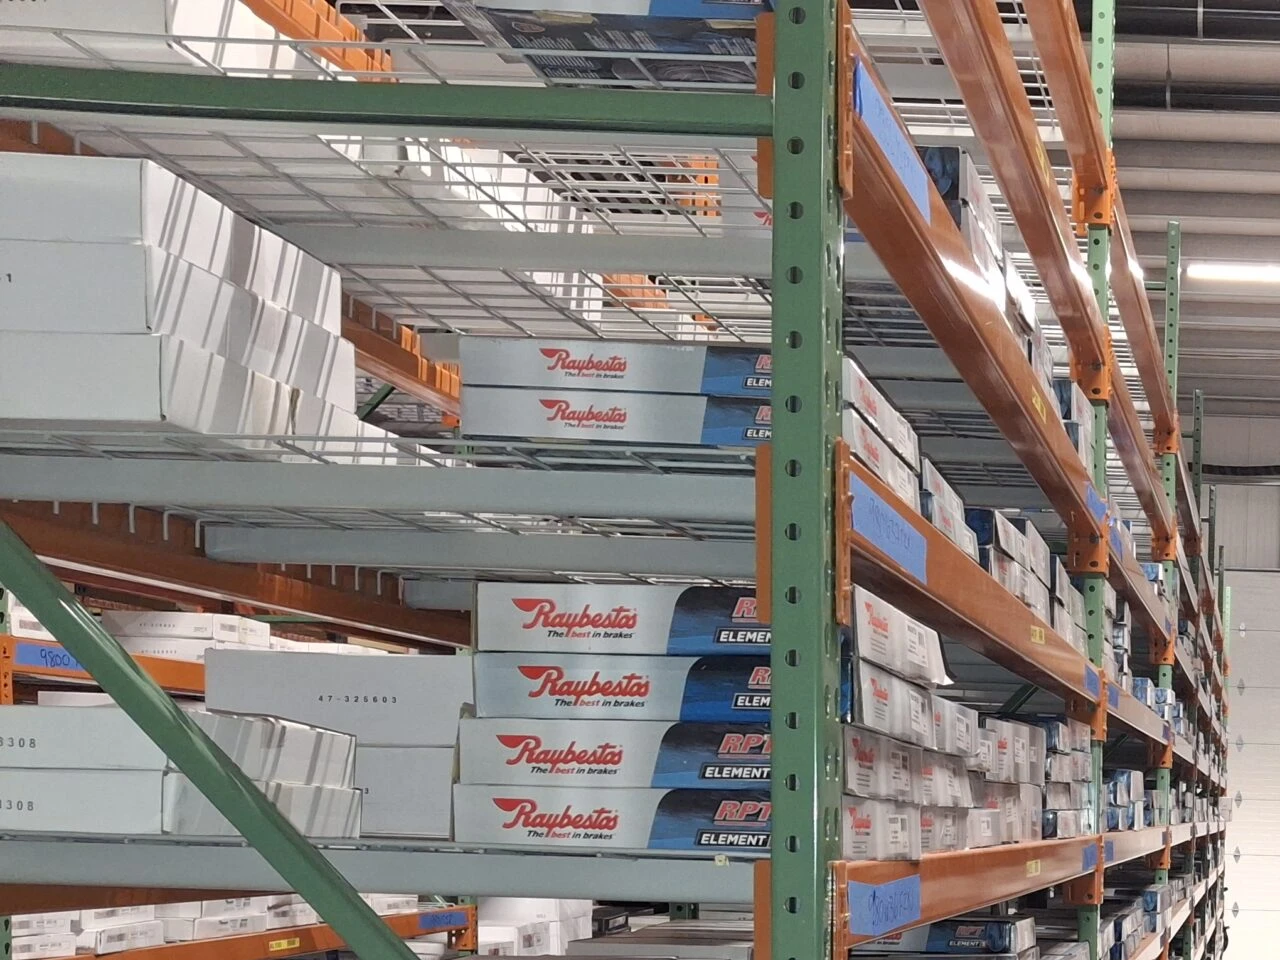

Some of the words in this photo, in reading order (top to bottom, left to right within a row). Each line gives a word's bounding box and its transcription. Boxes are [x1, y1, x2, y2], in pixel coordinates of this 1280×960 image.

[538, 348, 627, 377] Raybestos
[746, 378, 772, 388] ELEM
[538, 399, 627, 428] Raybestos
[746, 429, 772, 439] ELEM
[511, 598, 638, 638] Raybestos
[547, 630, 564, 638] The
[570, 630, 591, 639] best
[592, 630, 602, 639] in
[603, 630, 634, 640] brakes
[517, 665, 650, 706] Raybestos
[554, 699, 572, 707] The
[578, 698, 600, 707] best
[601, 699, 611, 707] in
[612, 699, 646, 708] brakes
[736, 696, 770, 707] ELEM
[495, 734, 624, 774] Raybestos
[530, 766, 548, 774] The
[555, 766, 576, 775] best
[576, 766, 586, 775] in
[587, 767, 619, 776] brakes
[704, 767, 770, 779] ELEMENT
[493, 797, 619, 837] Raybestos
[527, 830, 545, 838] The
[550, 830, 571, 839] best
[572, 831, 582, 839] in
[582, 831, 613, 840] brakes
[700, 834, 766, 846] ELEMENT
